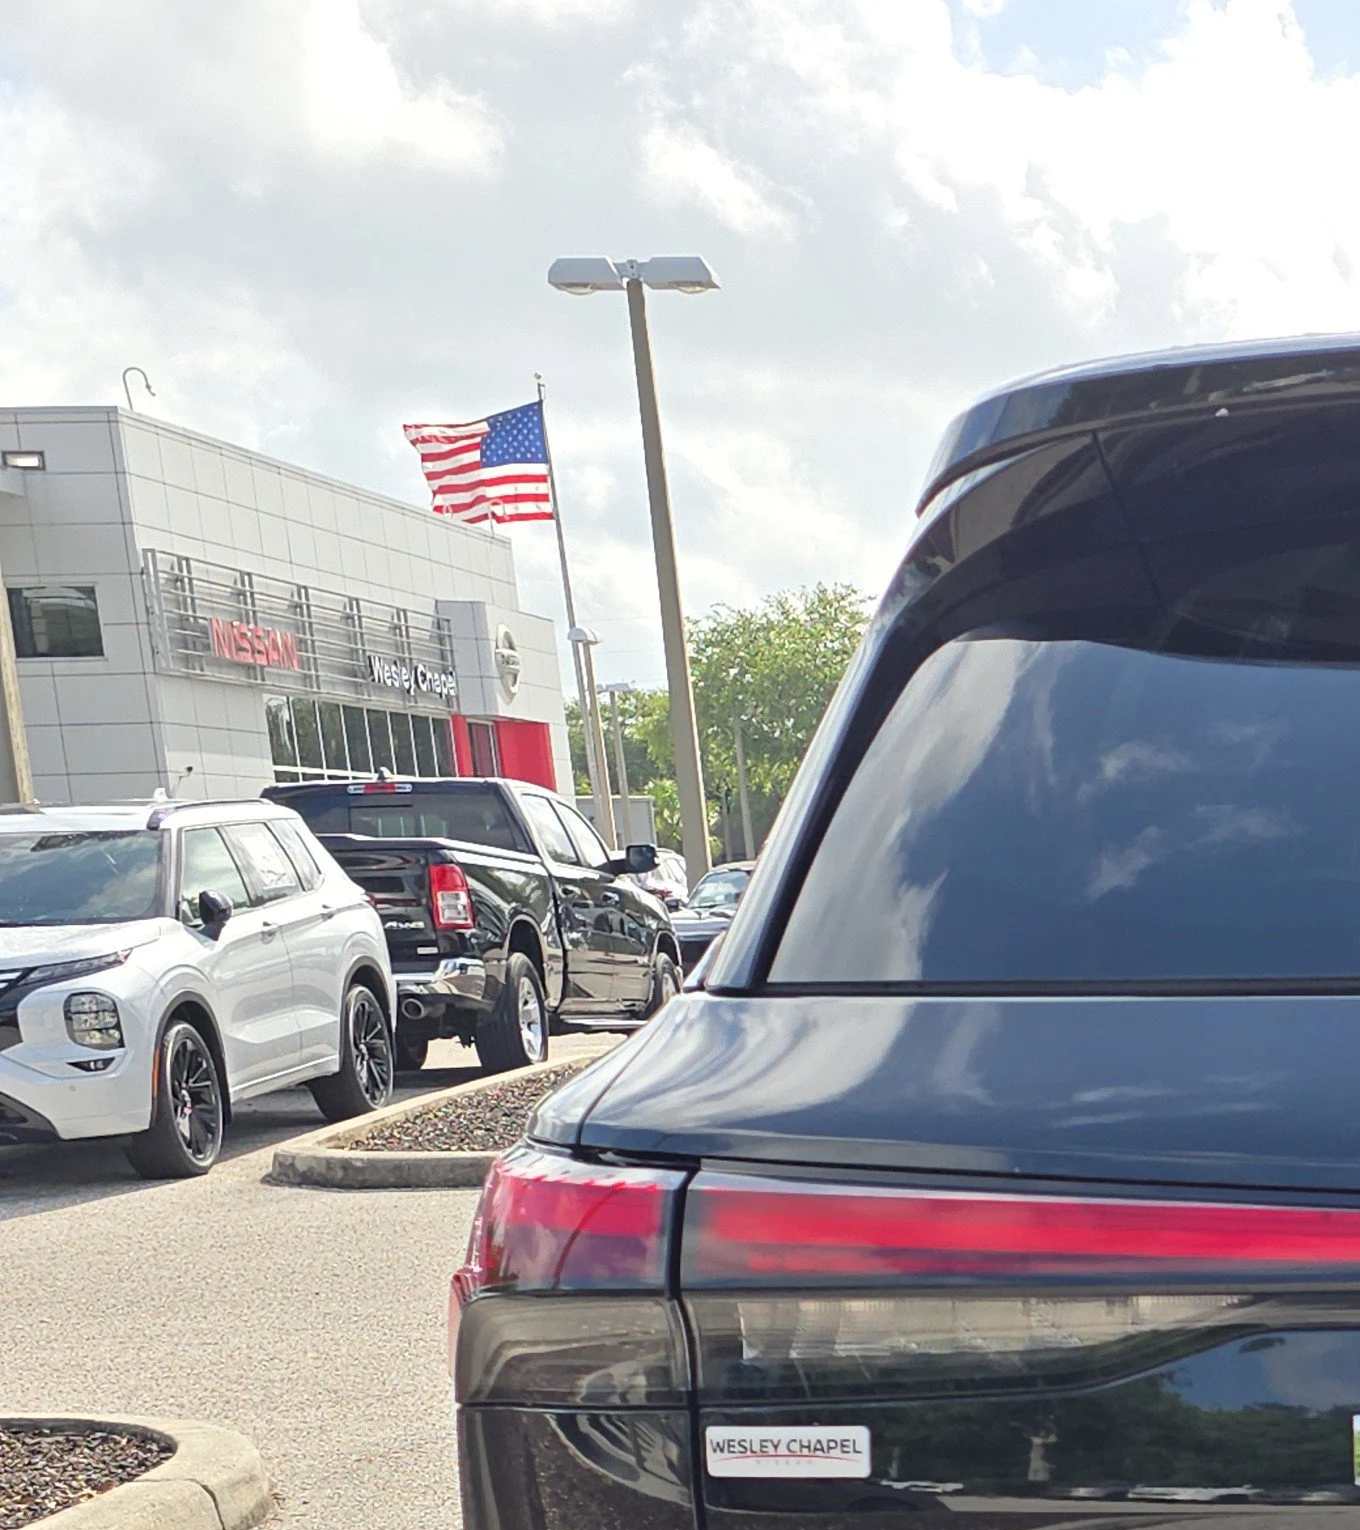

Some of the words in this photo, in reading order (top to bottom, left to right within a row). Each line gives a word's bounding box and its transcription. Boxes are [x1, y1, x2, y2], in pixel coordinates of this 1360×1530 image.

[208, 617, 299, 671] NISSAN
[369, 655, 415, 696] Wesley
[416, 664, 457, 700] Chapel
[710, 1438, 781, 1454] WESLEY
[786, 1438, 862, 1454] CHAPEL
